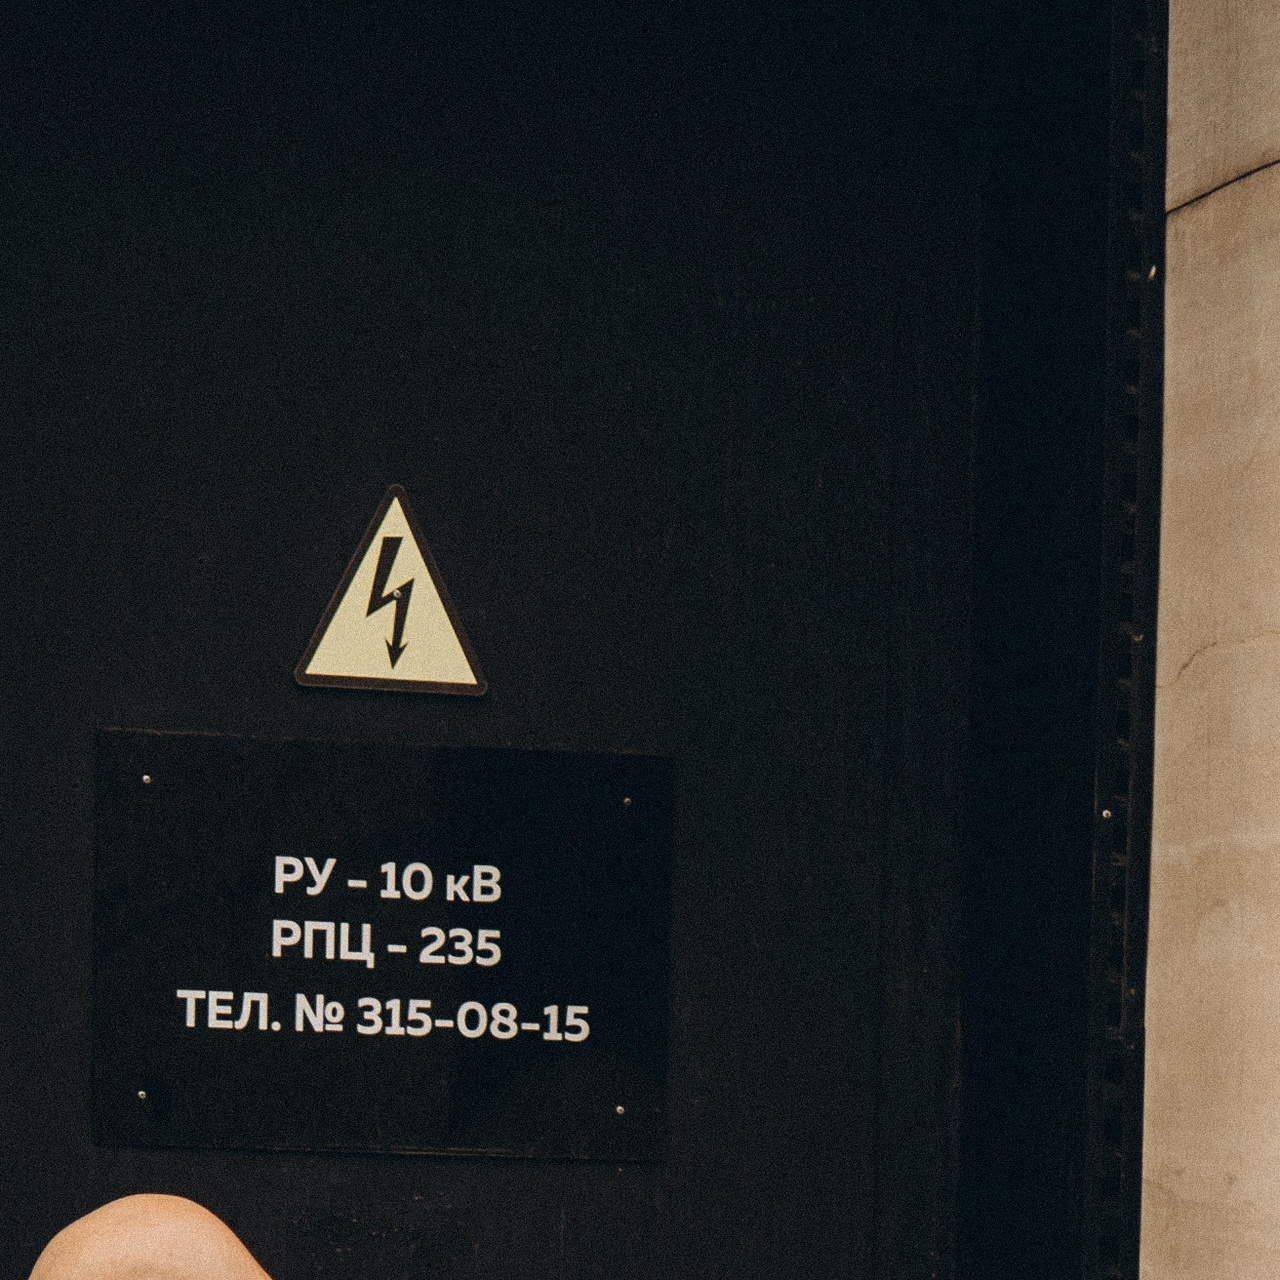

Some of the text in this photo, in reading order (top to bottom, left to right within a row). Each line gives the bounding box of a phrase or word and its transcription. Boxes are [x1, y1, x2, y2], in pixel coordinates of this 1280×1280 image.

[274, 855, 337, 896] РУ
[380, 861, 434, 901] 10
[446, 864, 502, 902] кВ
[272, 919, 375, 969] РПЦ
[419, 926, 502, 967] 235
[176, 989, 590, 1042] ТЕЛ. № 315-08-15
